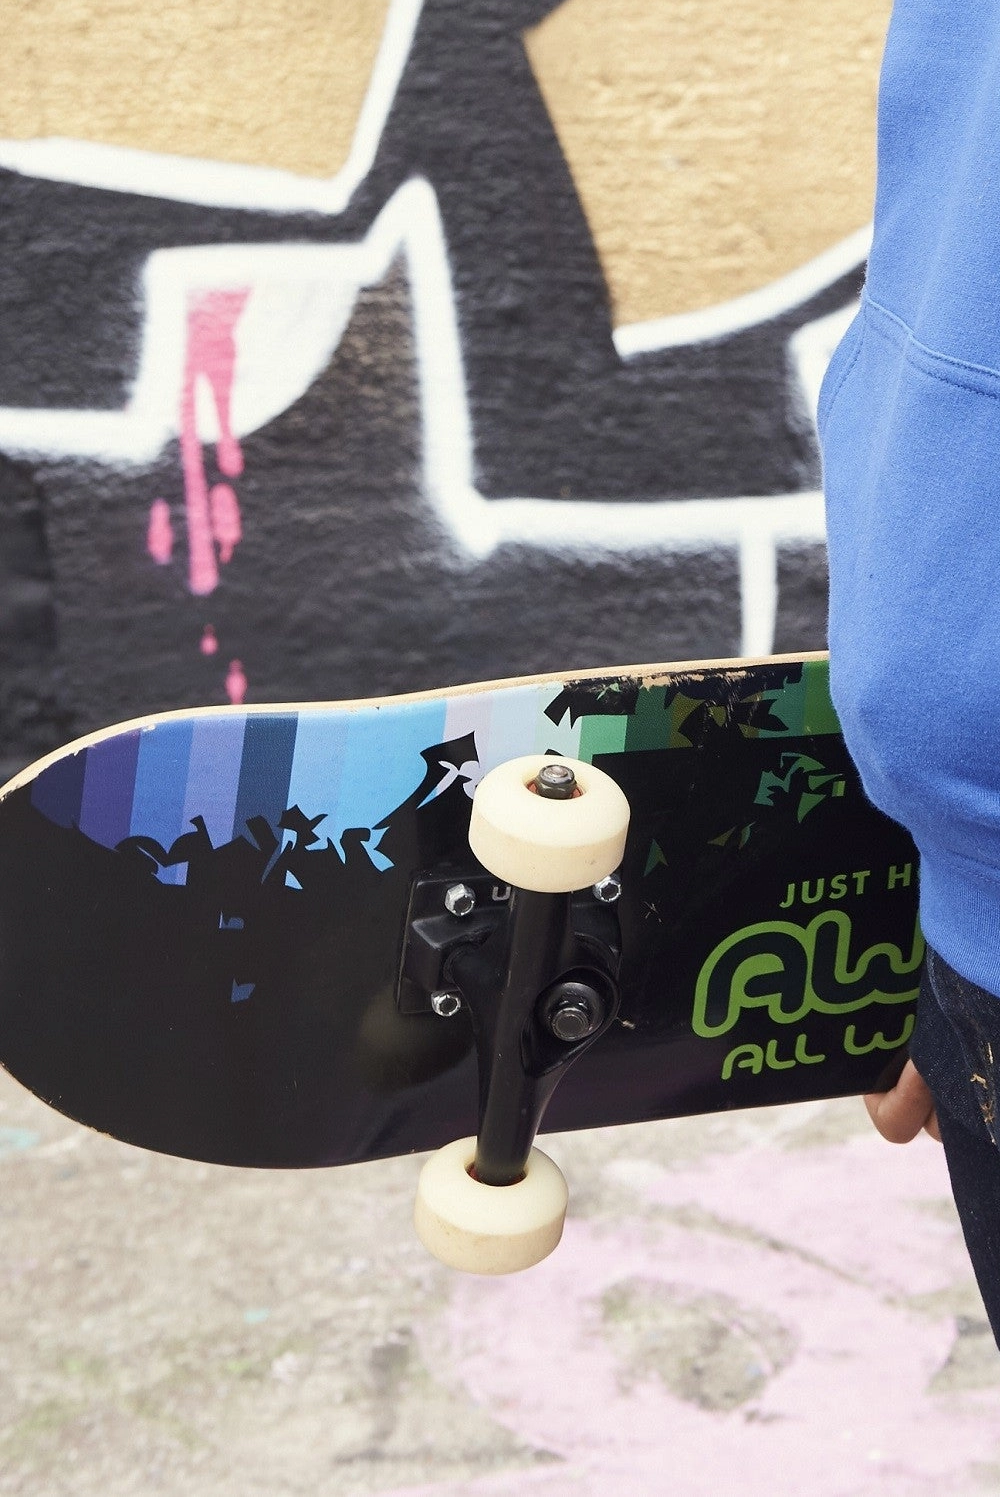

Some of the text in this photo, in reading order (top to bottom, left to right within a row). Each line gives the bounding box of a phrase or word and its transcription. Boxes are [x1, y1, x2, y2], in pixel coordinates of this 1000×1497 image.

[779, 863, 919, 909] JUST H
[720, 1033, 826, 1080] ALL
